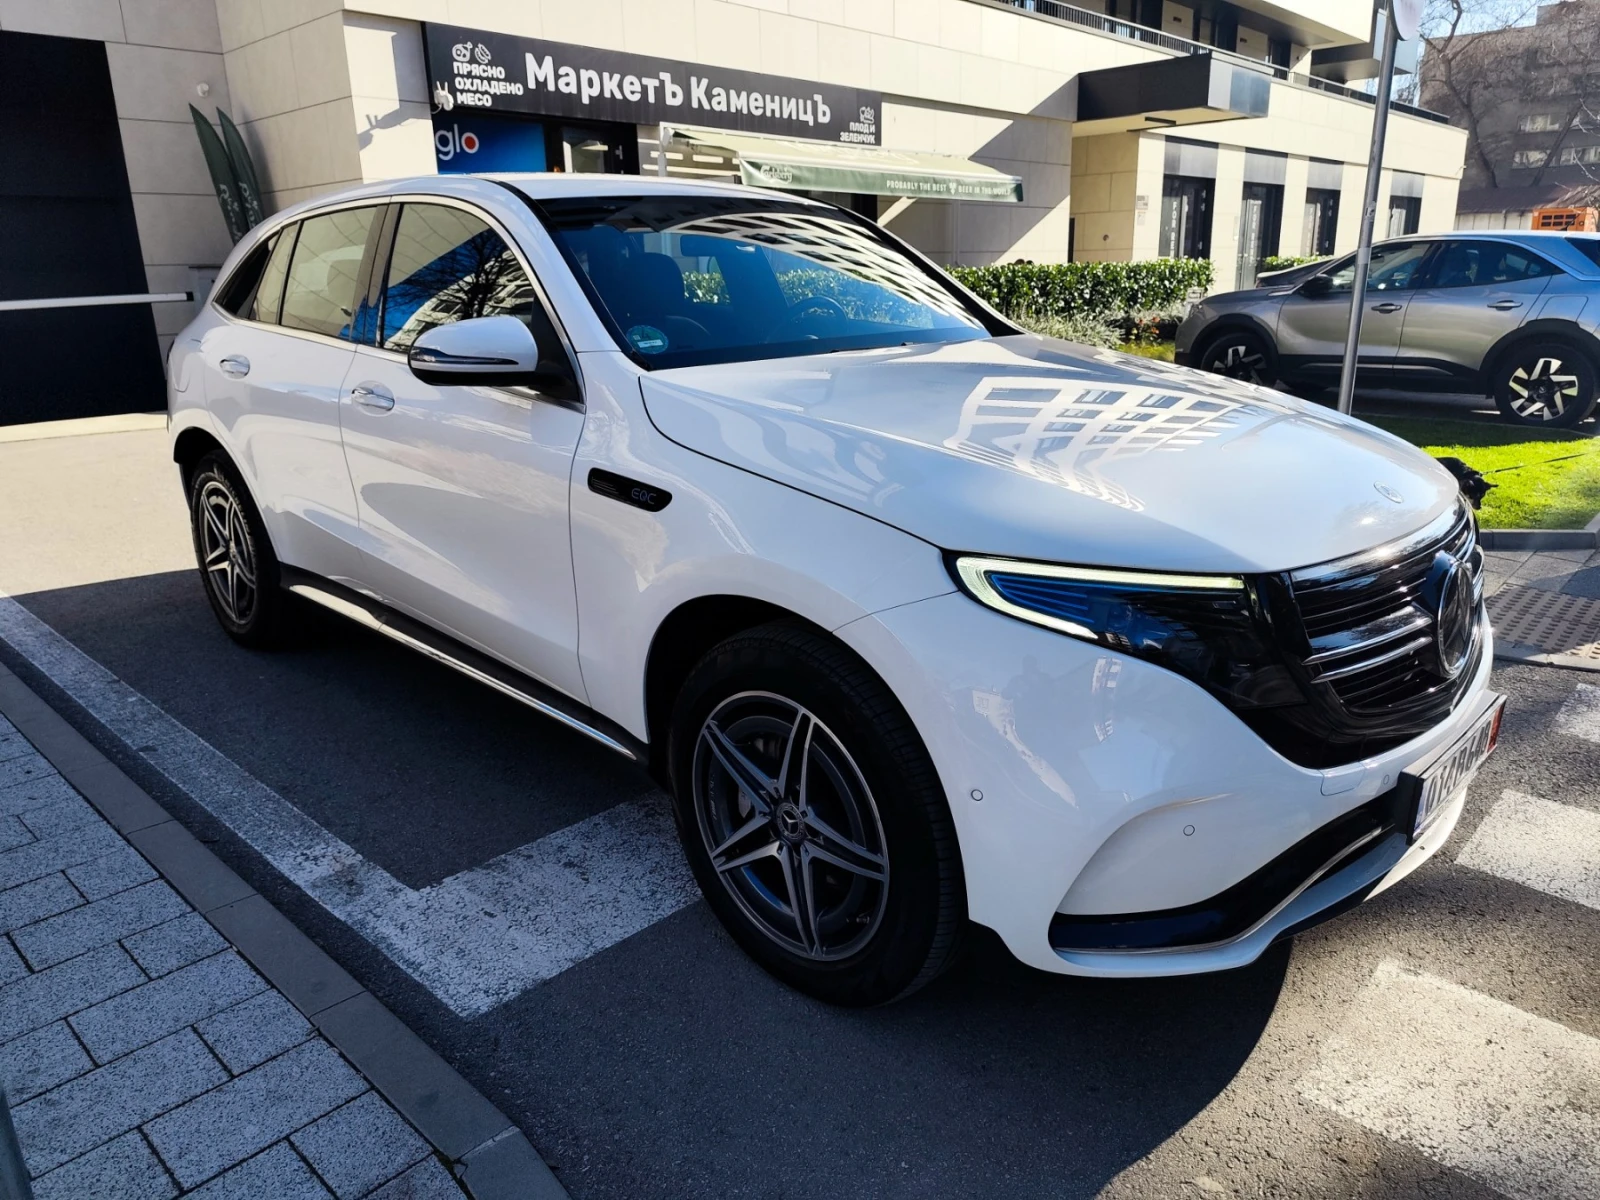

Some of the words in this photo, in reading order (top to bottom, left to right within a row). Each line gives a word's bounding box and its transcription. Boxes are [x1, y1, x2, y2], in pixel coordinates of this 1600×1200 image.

[453, 61, 506, 79] ПРЯСНО
[454, 77, 524, 96] ОХЛАДЕНО
[525, 52, 684, 106] МаркетЪ
[690, 76, 831, 127] КаменицЪ
[456, 92, 493, 107] МЕСО
[849, 121, 869, 134] ПЛОД
[869, 124, 876, 134] И
[434, 123, 480, 161] glo
[839, 131, 876, 144] ЗЕЛЕНЧУК
[886, 180, 918, 190] PROBABLY
[919, 183, 931, 191] THE
[932, 183, 947, 192] BEST
[958, 185, 973, 193] BEER
[631, 487, 657, 505] EQC
